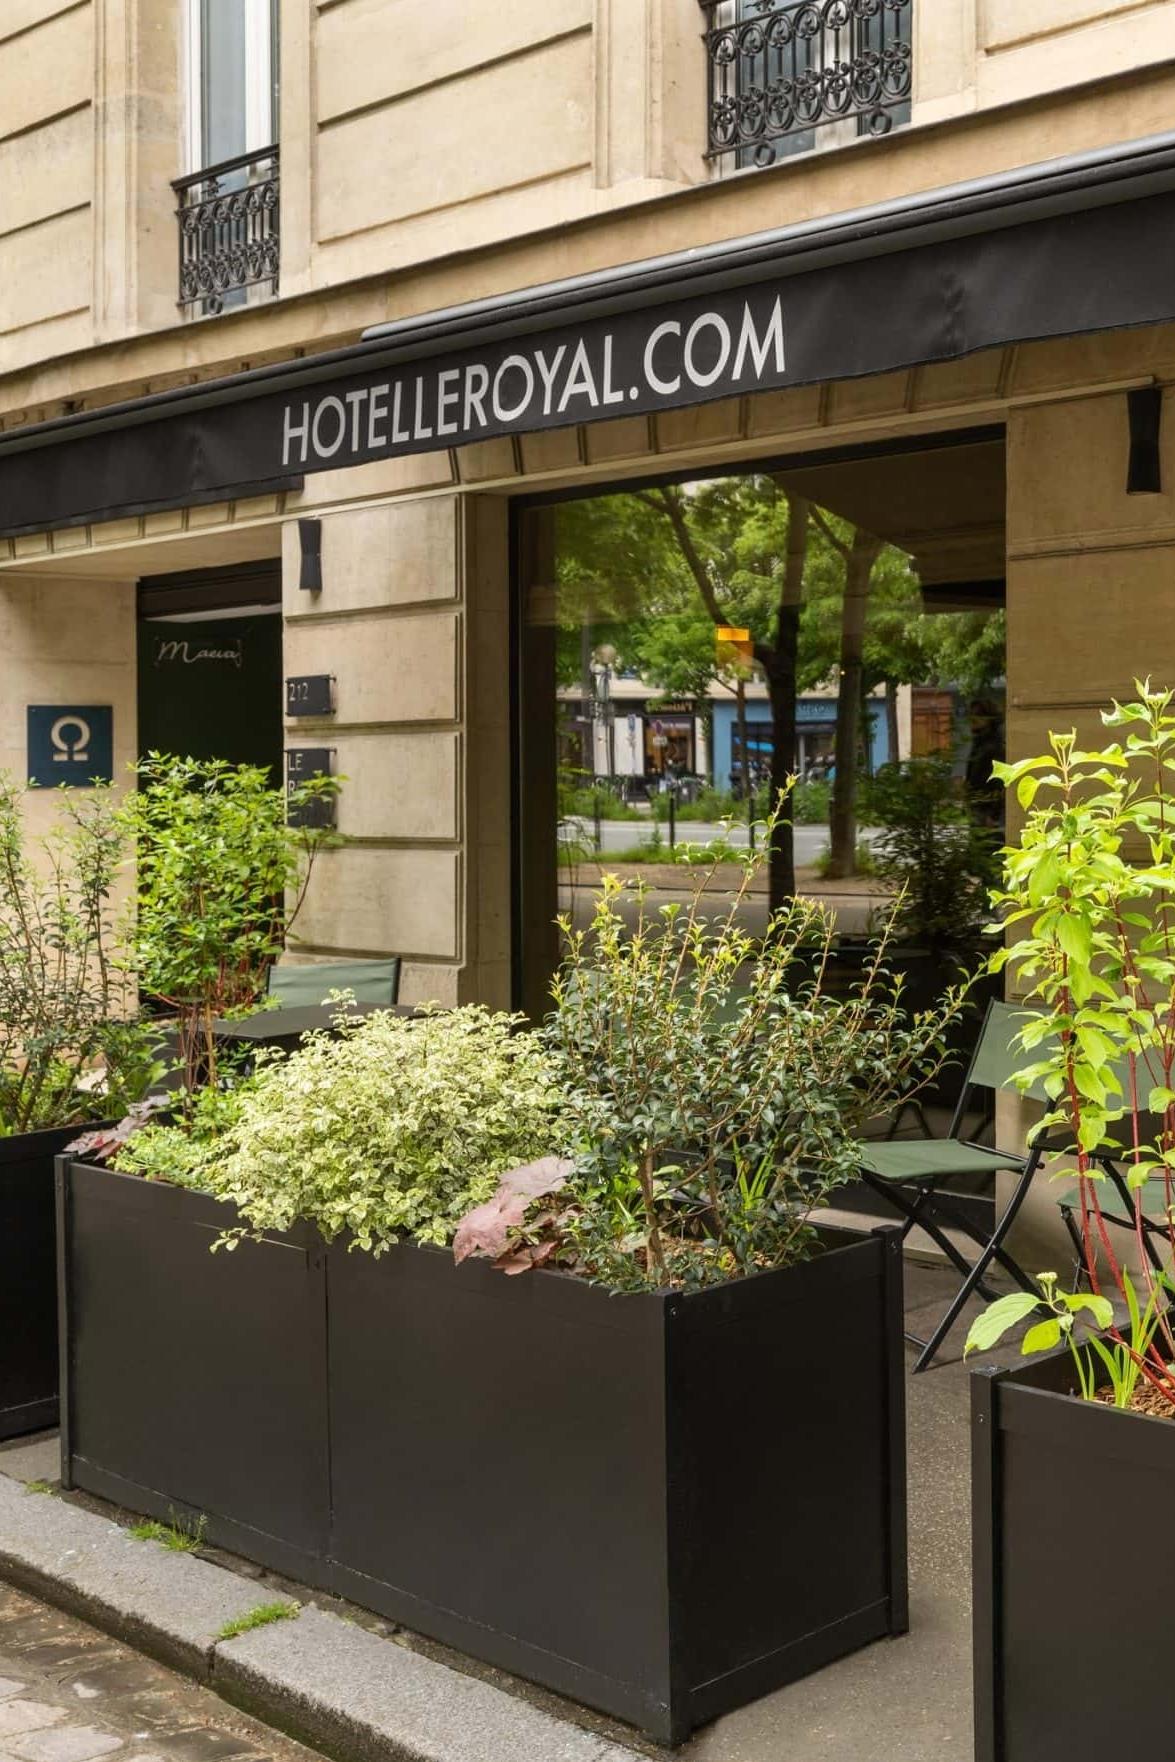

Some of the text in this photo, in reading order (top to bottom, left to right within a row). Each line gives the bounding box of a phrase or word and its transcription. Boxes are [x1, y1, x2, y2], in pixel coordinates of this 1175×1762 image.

[281, 294, 787, 466] HOTELLEROYAL.COM
[288, 682, 309, 701] 212
[288, 753, 304, 771] LE
